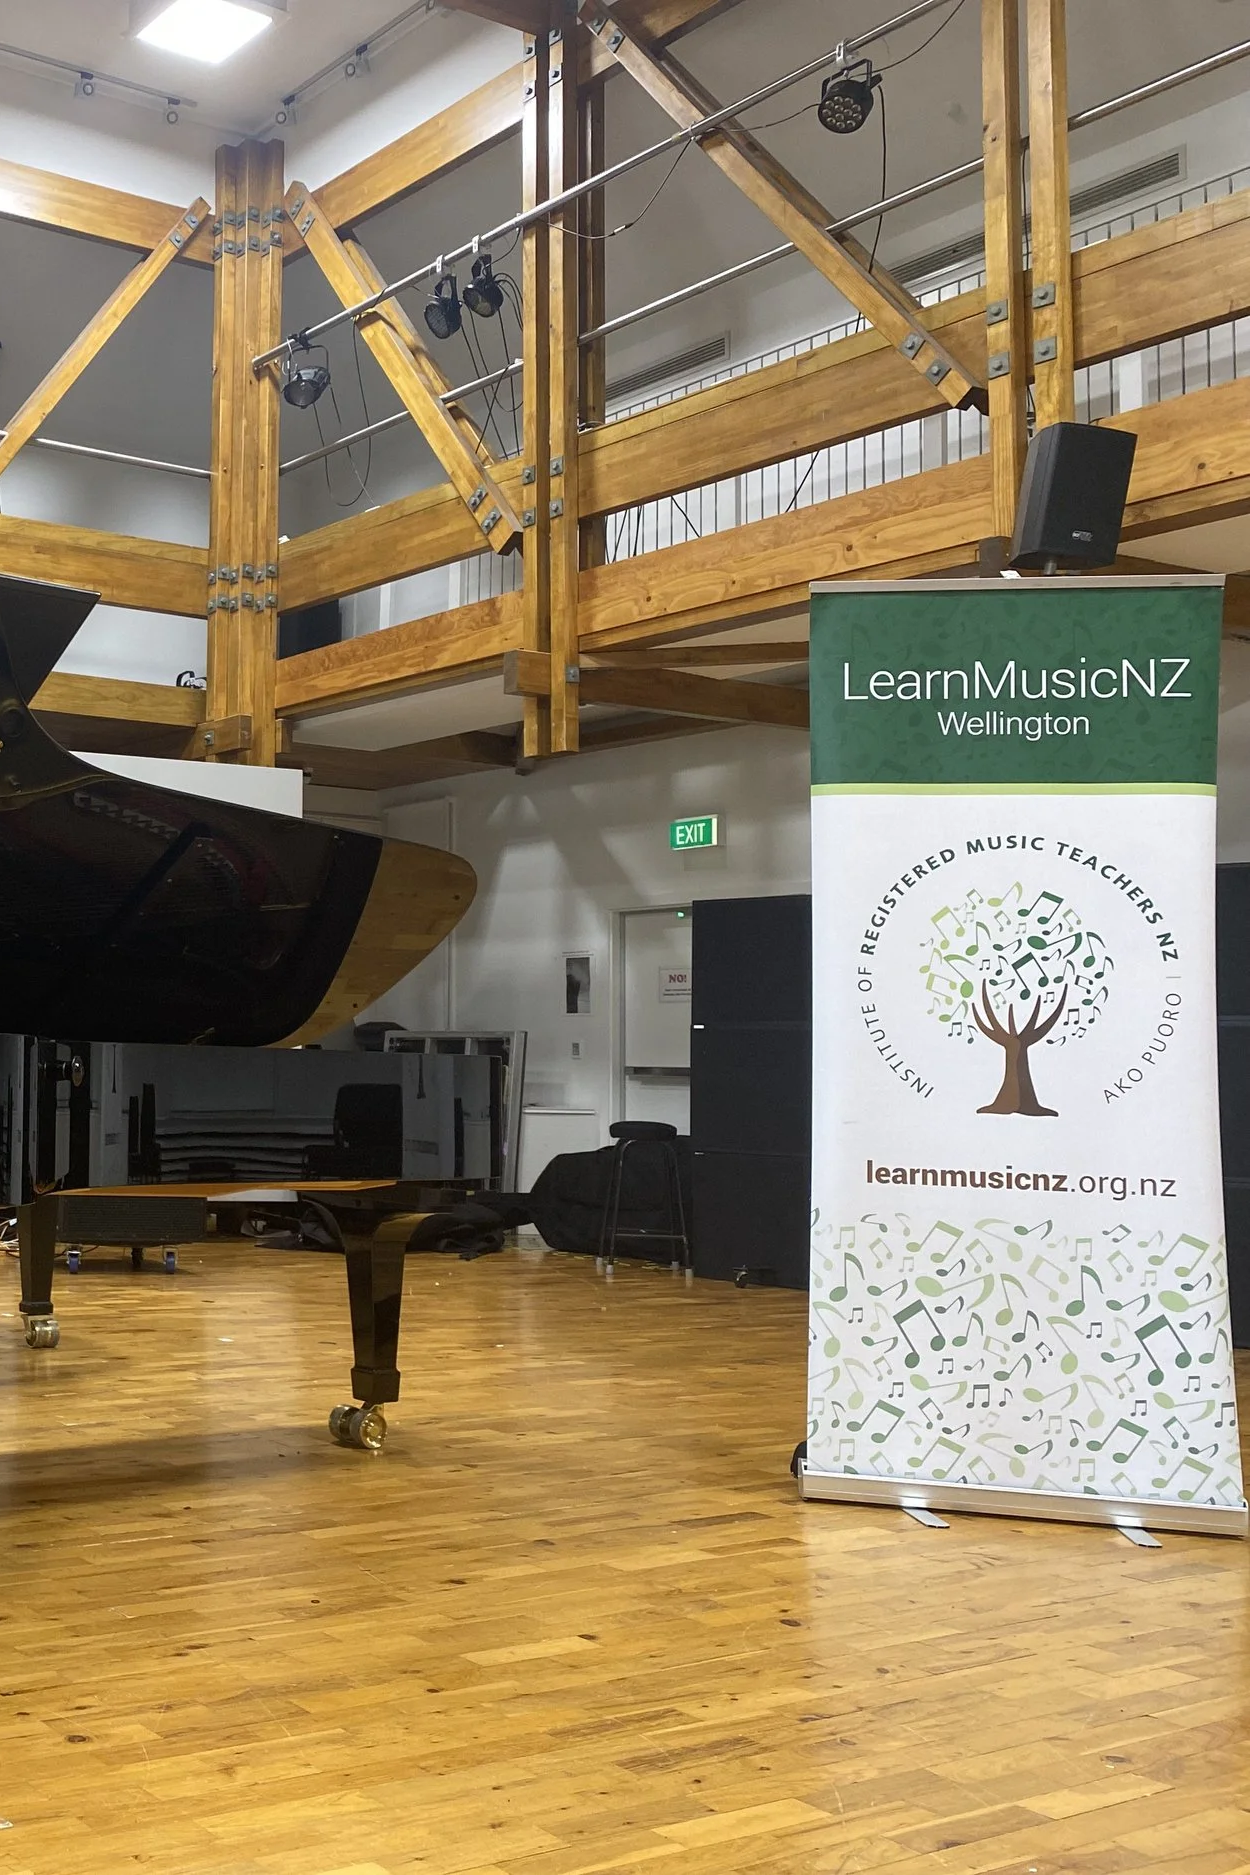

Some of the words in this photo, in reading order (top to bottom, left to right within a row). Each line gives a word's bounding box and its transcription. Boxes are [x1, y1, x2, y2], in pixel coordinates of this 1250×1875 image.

[843, 657, 1192, 701] LearnMusicNZ
[937, 711, 1090, 742] Wellington
[676, 823, 706, 845] EXIT
[966, 835, 1045, 855] MUSIC
[1056, 841, 1164, 925] TEACHERS
[860, 848, 956, 956] REGISTERED
[1156, 932, 1179, 962] NZ
[668, 974, 687, 984] NO!
[857, 966, 873, 992] OF
[861, 1003, 934, 1099] INSTITUTE
[1103, 1067, 1144, 1104] AKO
[1141, 993, 1182, 1065] PUORO
[866, 1159, 1178, 1202] learnmusicnz.org.nz
